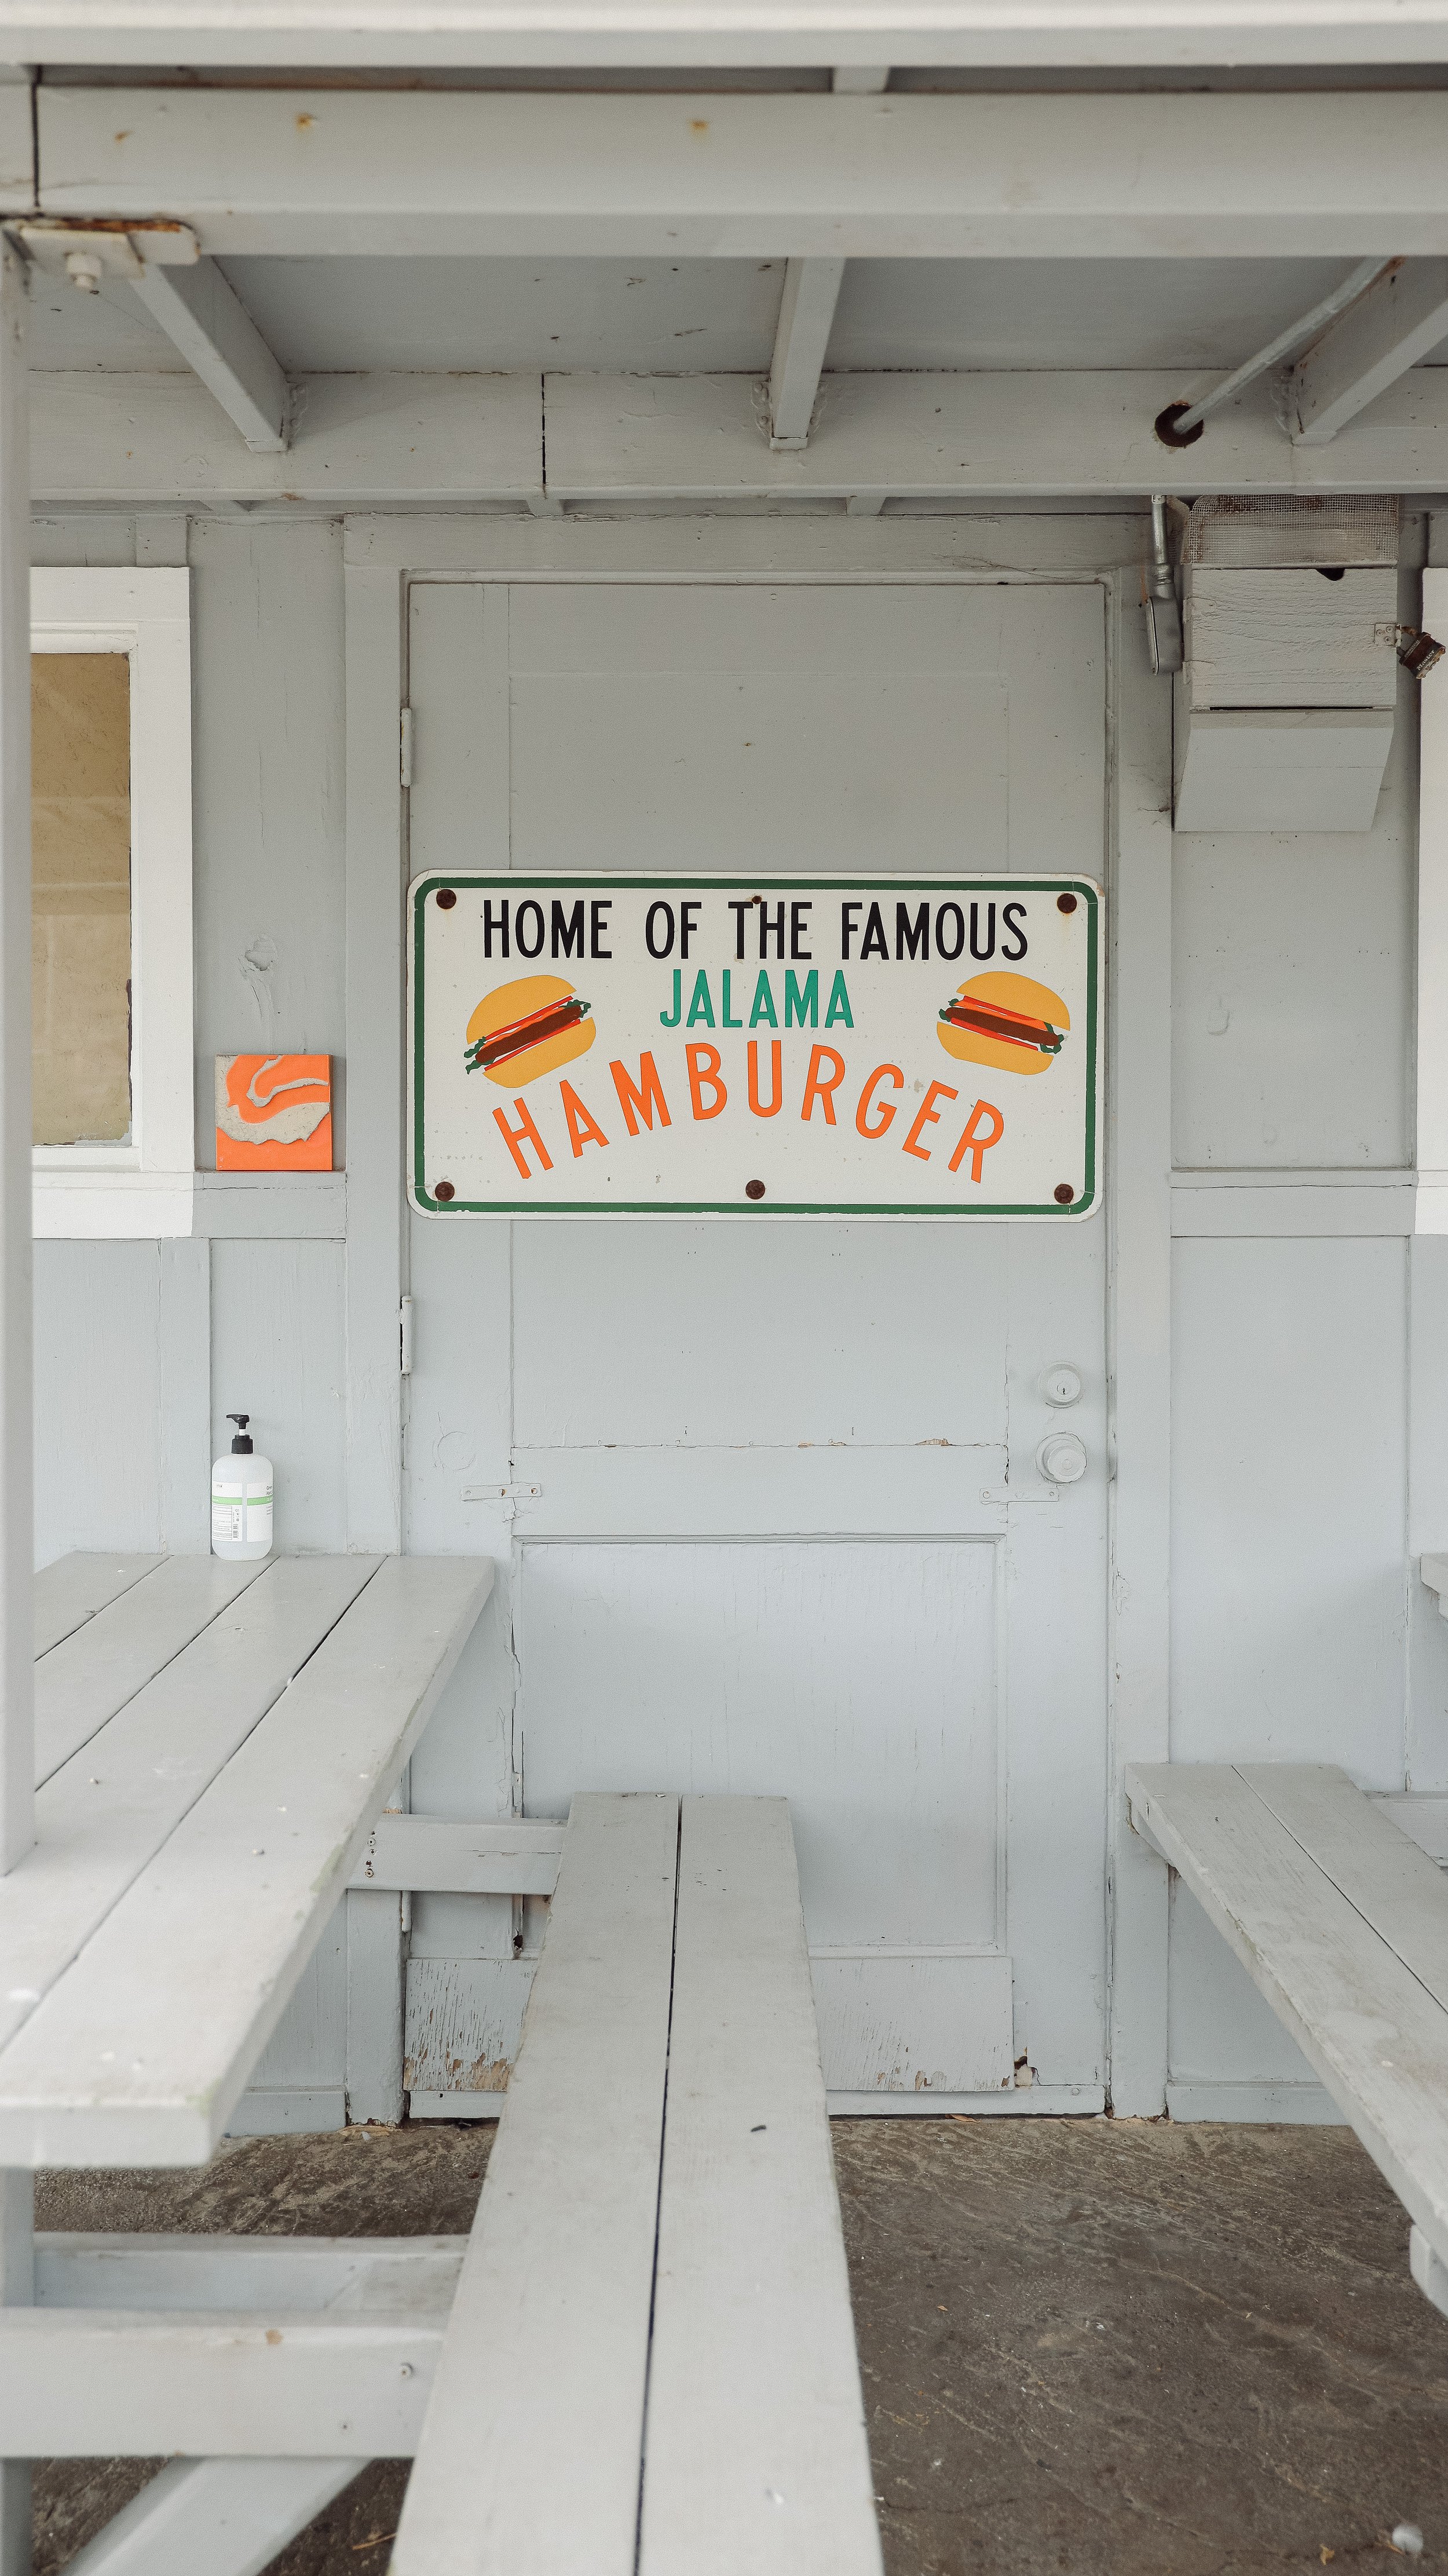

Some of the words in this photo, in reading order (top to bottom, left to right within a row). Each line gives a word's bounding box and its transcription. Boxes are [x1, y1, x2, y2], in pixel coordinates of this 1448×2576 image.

[1416, 650, 1435, 670] Master
[484, 899, 613, 959] HOME
[645, 901, 703, 959] OF
[728, 901, 813, 960] THE
[842, 902, 1029, 961] FAMOUS
[659, 969, 854, 1028] JALAMA
[492, 1040, 1005, 1184] HAMBURGER
